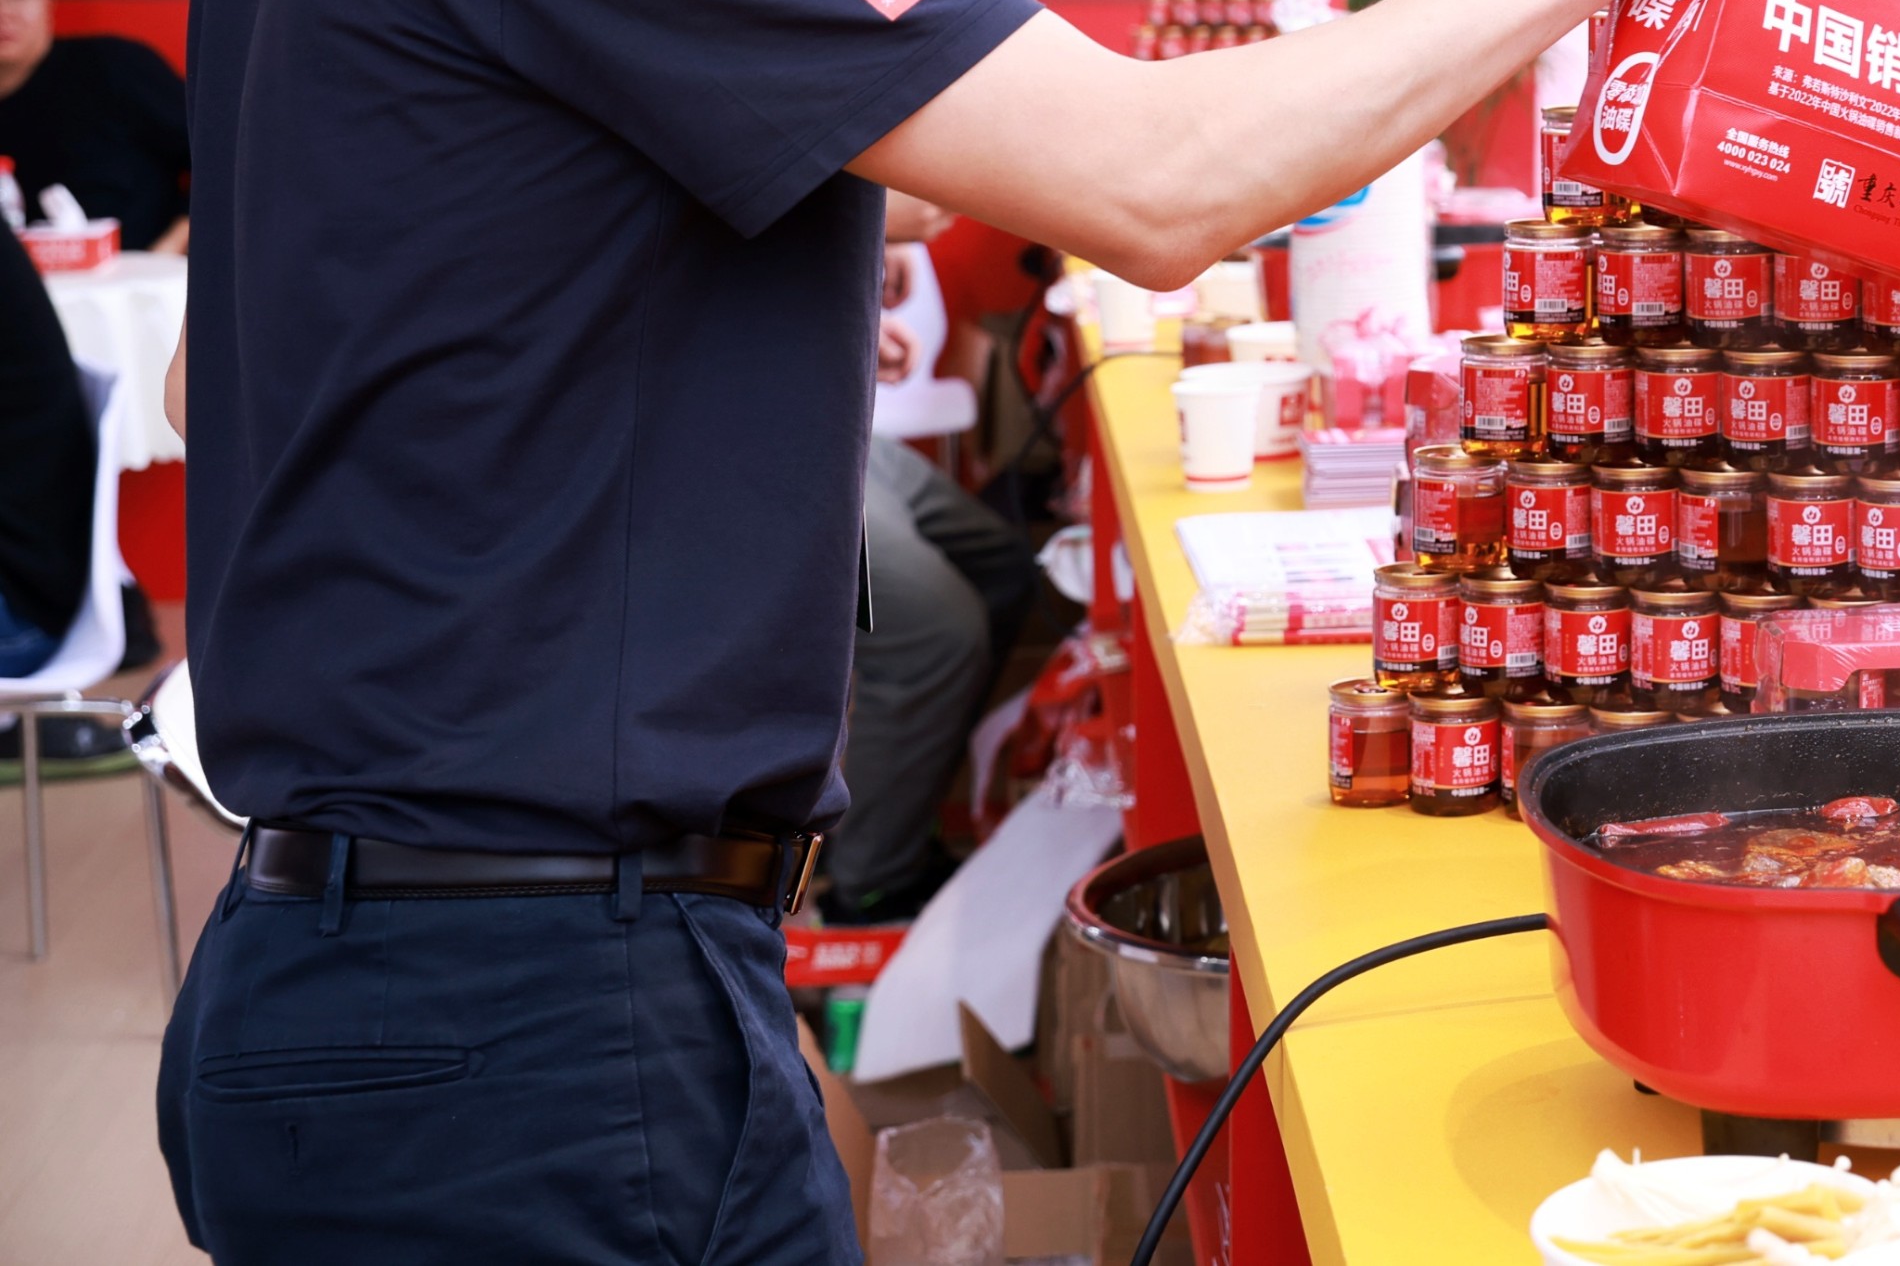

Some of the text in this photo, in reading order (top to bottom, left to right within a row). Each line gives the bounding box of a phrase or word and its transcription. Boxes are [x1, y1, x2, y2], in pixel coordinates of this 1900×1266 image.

[1600, 105, 1634, 133] 油碟
[1717, 141, 1791, 174] 4000 023 024
[1725, 127, 1790, 159] 全国服务热线
[1704, 498, 1716, 508] F9
